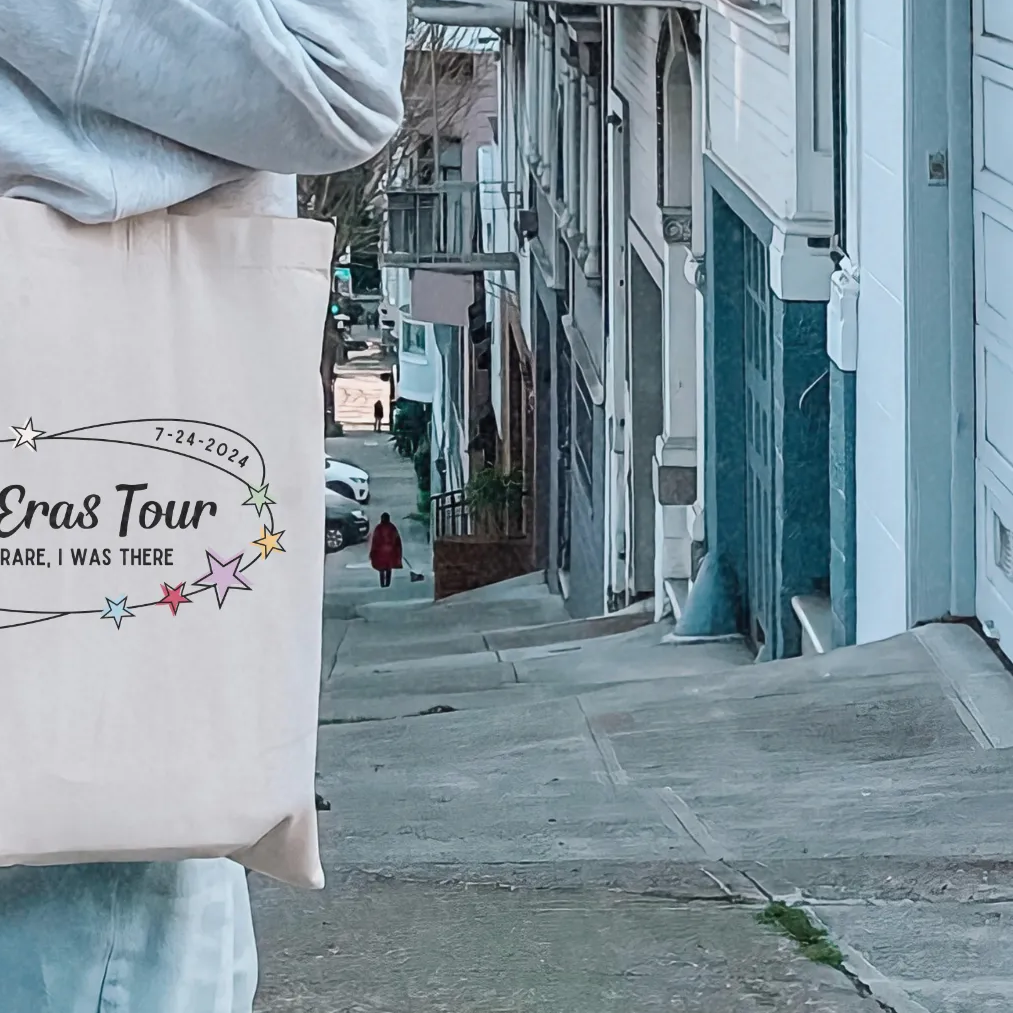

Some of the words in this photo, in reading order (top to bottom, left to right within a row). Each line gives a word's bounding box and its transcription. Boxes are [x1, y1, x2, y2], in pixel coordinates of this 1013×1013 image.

[155, 426, 250, 469] 7-24-2024
[115, 482, 218, 538] Tour
[0, 548, 51, 569] RARE,
[58, 548, 63, 566] I
[70, 548, 112, 566] WAS
[119, 548, 174, 566] THERE
